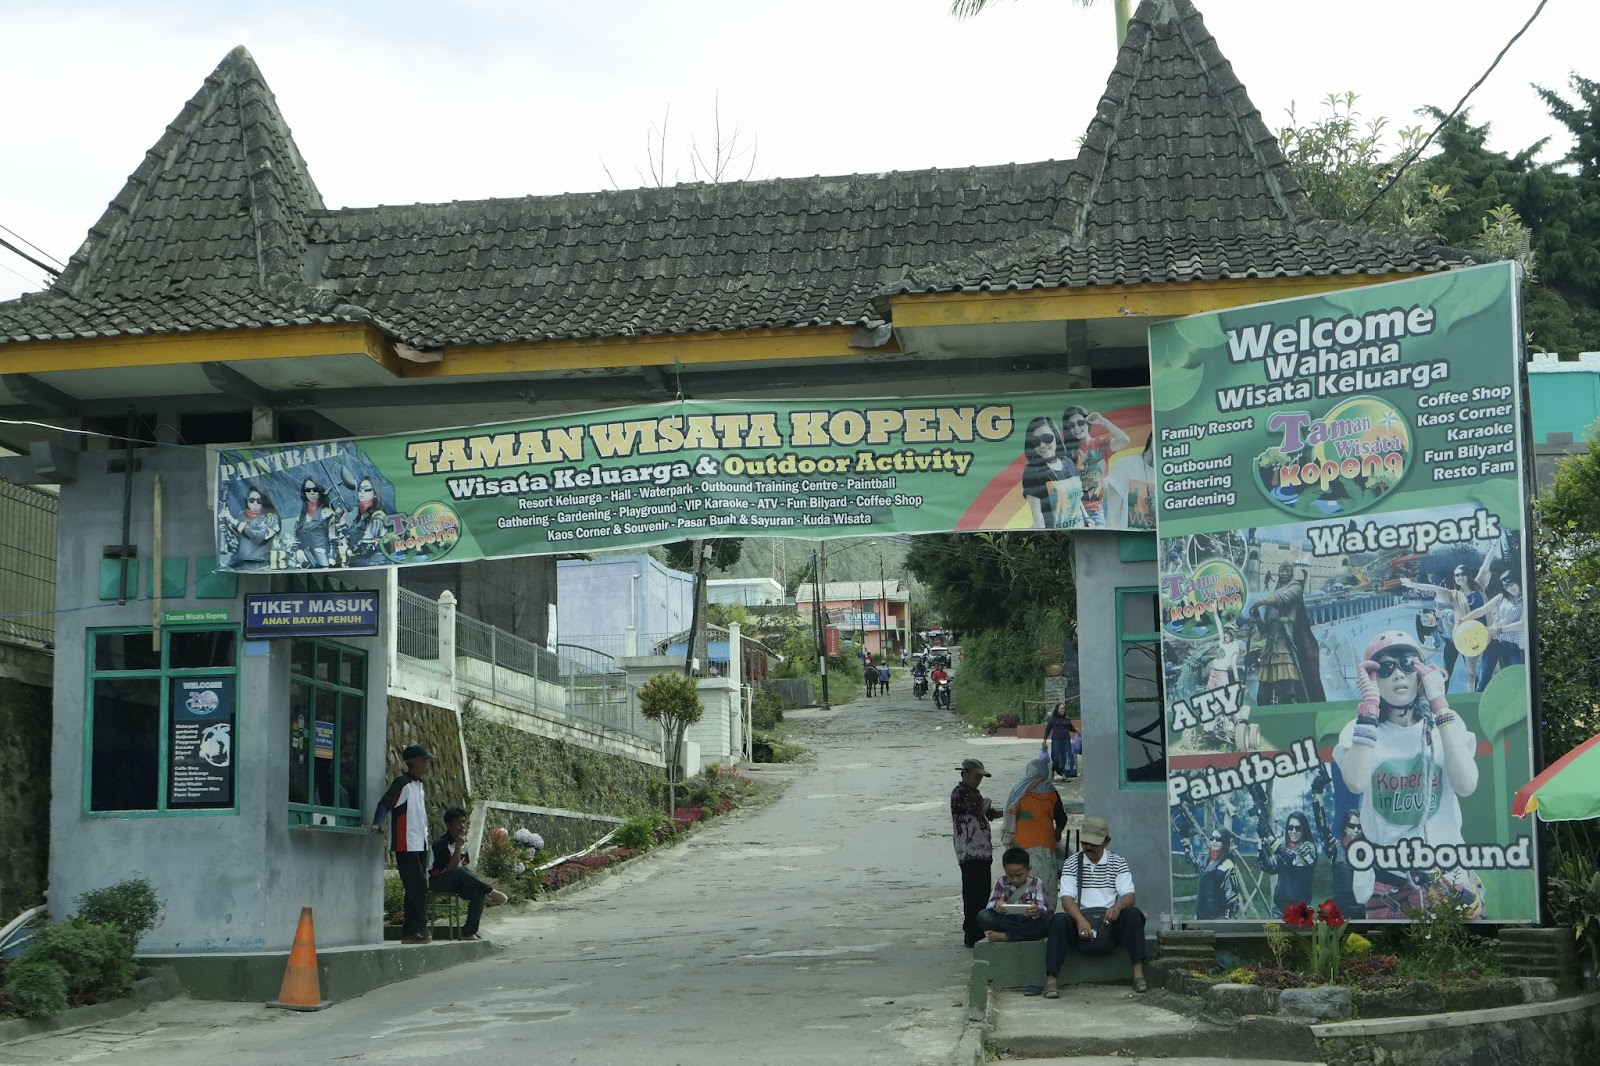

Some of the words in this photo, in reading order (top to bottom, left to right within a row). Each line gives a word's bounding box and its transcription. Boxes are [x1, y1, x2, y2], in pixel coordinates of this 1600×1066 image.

[1227, 306, 1434, 361] Welcome
[1266, 341, 1399, 380] Wahana
[1218, 380, 1310, 410] Wisata
[1318, 361, 1448, 396] Keluarga
[1418, 390, 1470, 408] Coffee
[1472, 385, 1512, 402] Shop
[1417, 411, 1455, 427] Kaos
[1458, 403, 1513, 420] Corner
[408, 426, 585, 474] TAMAN
[590, 413, 781, 458] WISATA
[790, 406, 1013, 446] KOPENG
[1161, 425, 1206, 441] Family
[1208, 418, 1253, 434] Resort
[1269, 413, 1371, 453] Taman
[1447, 422, 1513, 442] Karaoke
[1162, 444, 1189, 458] Hall
[1334, 436, 1401, 457] Wisata
[1424, 449, 1454, 464] Fun
[1458, 440, 1514, 460] Bilyard
[219, 442, 347, 482] PAINTBALL
[449, 473, 548, 498] Wisata
[554, 461, 690, 489] Keluarga
[696, 457, 717, 475] &
[724, 454, 851, 475] Outdoor
[856, 450, 971, 474] Activity
[1162, 456, 1232, 475] Outbound
[1433, 466, 1477, 481] Resto
[1481, 460, 1515, 476] Fam
[518, 497, 553, 510] Resort
[555, 493, 602, 507] Keluarga
[610, 488, 631, 501] Hall
[639, 483, 694, 499] Waterpark
[701, 480, 752, 493] Outbound
[755, 481, 799, 494] Training
[801, 479, 838, 491] Centre
[847, 477, 896, 490] Paintball
[1163, 474, 1232, 493] Gathering
[497, 514, 549, 529] Gathering
[557, 509, 612, 523] Gardening
[619, 502, 677, 518] Playground
[684, 499, 702, 512] VIP
[704, 497, 749, 510] Karaoke
[757, 498, 778, 509] ATV
[786, 497, 807, 509] Fun
[809, 496, 847, 510] Bilyard
[856, 495, 892, 507] Coffee
[894, 494, 923, 508] Shop
[1164, 491, 1235, 510] Gardening
[386, 512, 438, 535] Taman
[547, 529, 574, 541] Kaos
[576, 526, 610, 539] Corner
[612, 524, 622, 535] &
[623, 520, 669, 534] Souvenir
[677, 517, 707, 529] Pasar
[709, 514, 737, 526] Buah
[739, 515, 749, 526] &
[750, 515, 794, 528] Sayuran
[803, 514, 831, 525] Kuda
[834, 512, 872, 525] Wisata
[1309, 510, 1500, 556] Waterpark
[1161, 573, 1220, 600] Taman
[206, 612, 228, 620] Kopeng
[250, 600, 304, 614] TIKET
[308, 598, 374, 613] MASUK
[262, 617, 290, 625] ANAK
[292, 616, 325, 625] BAYAR
[327, 615, 362, 624] PENUH
[183, 681, 223, 690] WELCOME
[1172, 684, 1242, 730] ATV
[1169, 739, 1321, 802] Paintball
[1348, 837, 1531, 870] Outbound
